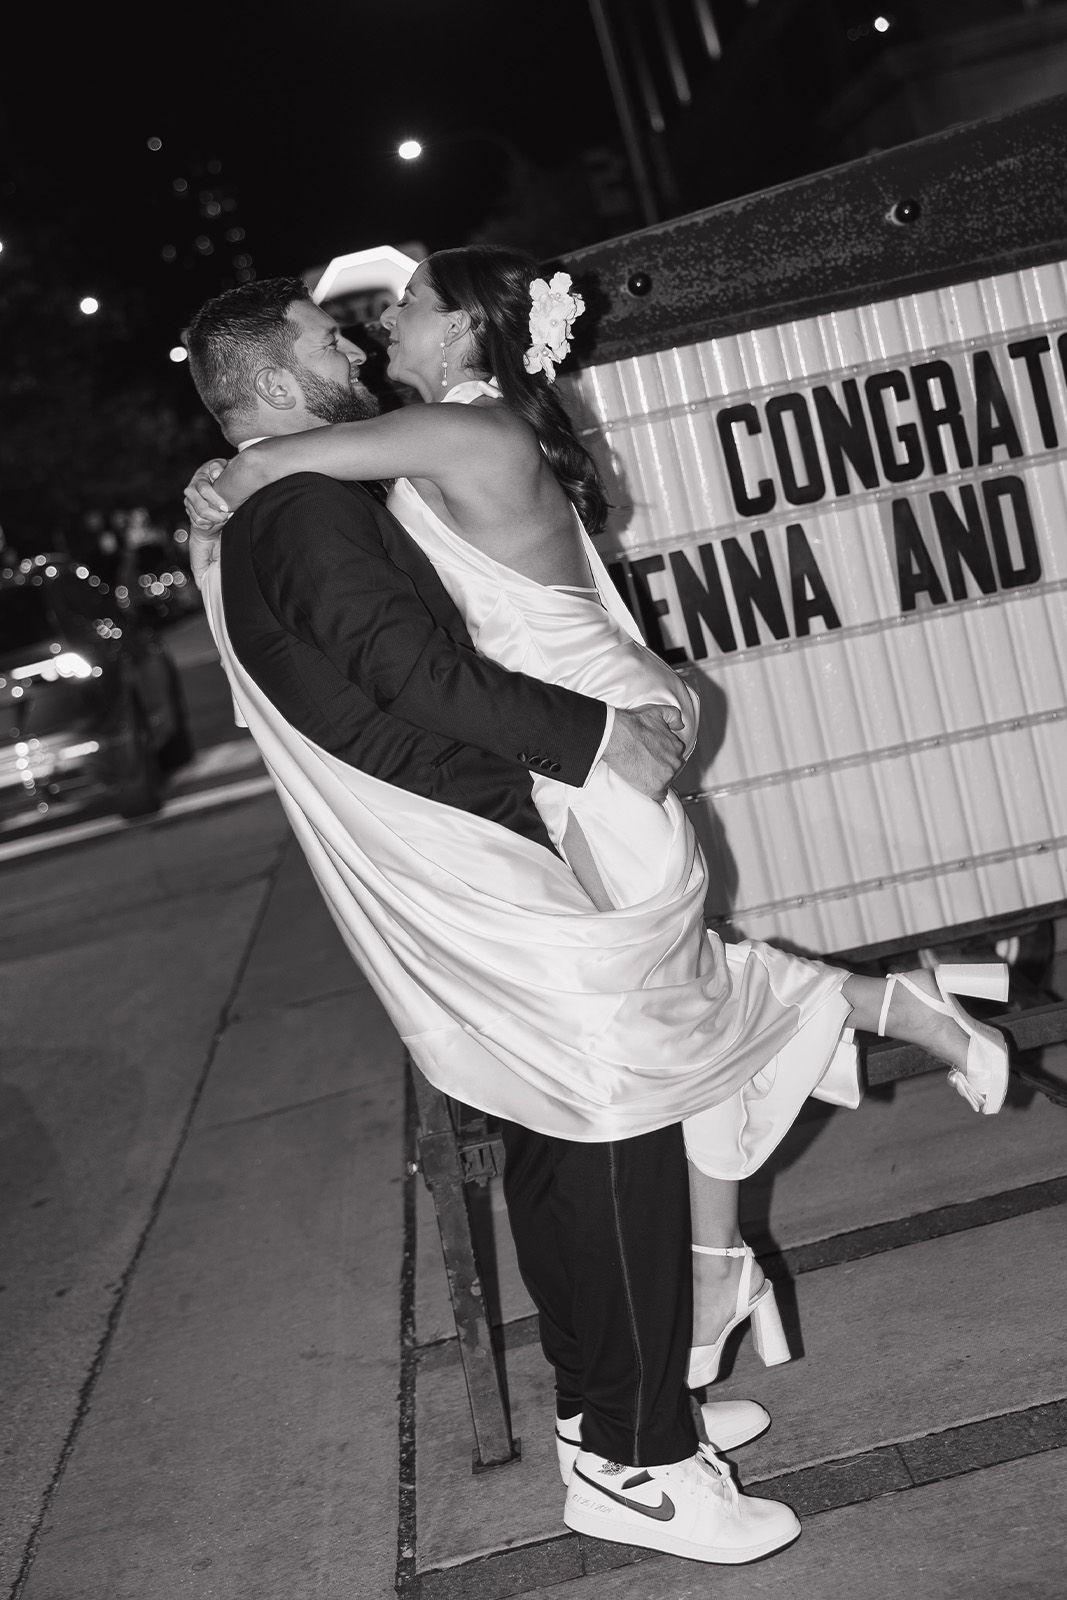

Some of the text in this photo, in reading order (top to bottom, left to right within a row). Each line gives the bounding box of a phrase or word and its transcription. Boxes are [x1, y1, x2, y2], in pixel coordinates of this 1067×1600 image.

[716, 333, 1067, 517] CONGRAT
[608, 475, 1042, 665] ENNA AND
